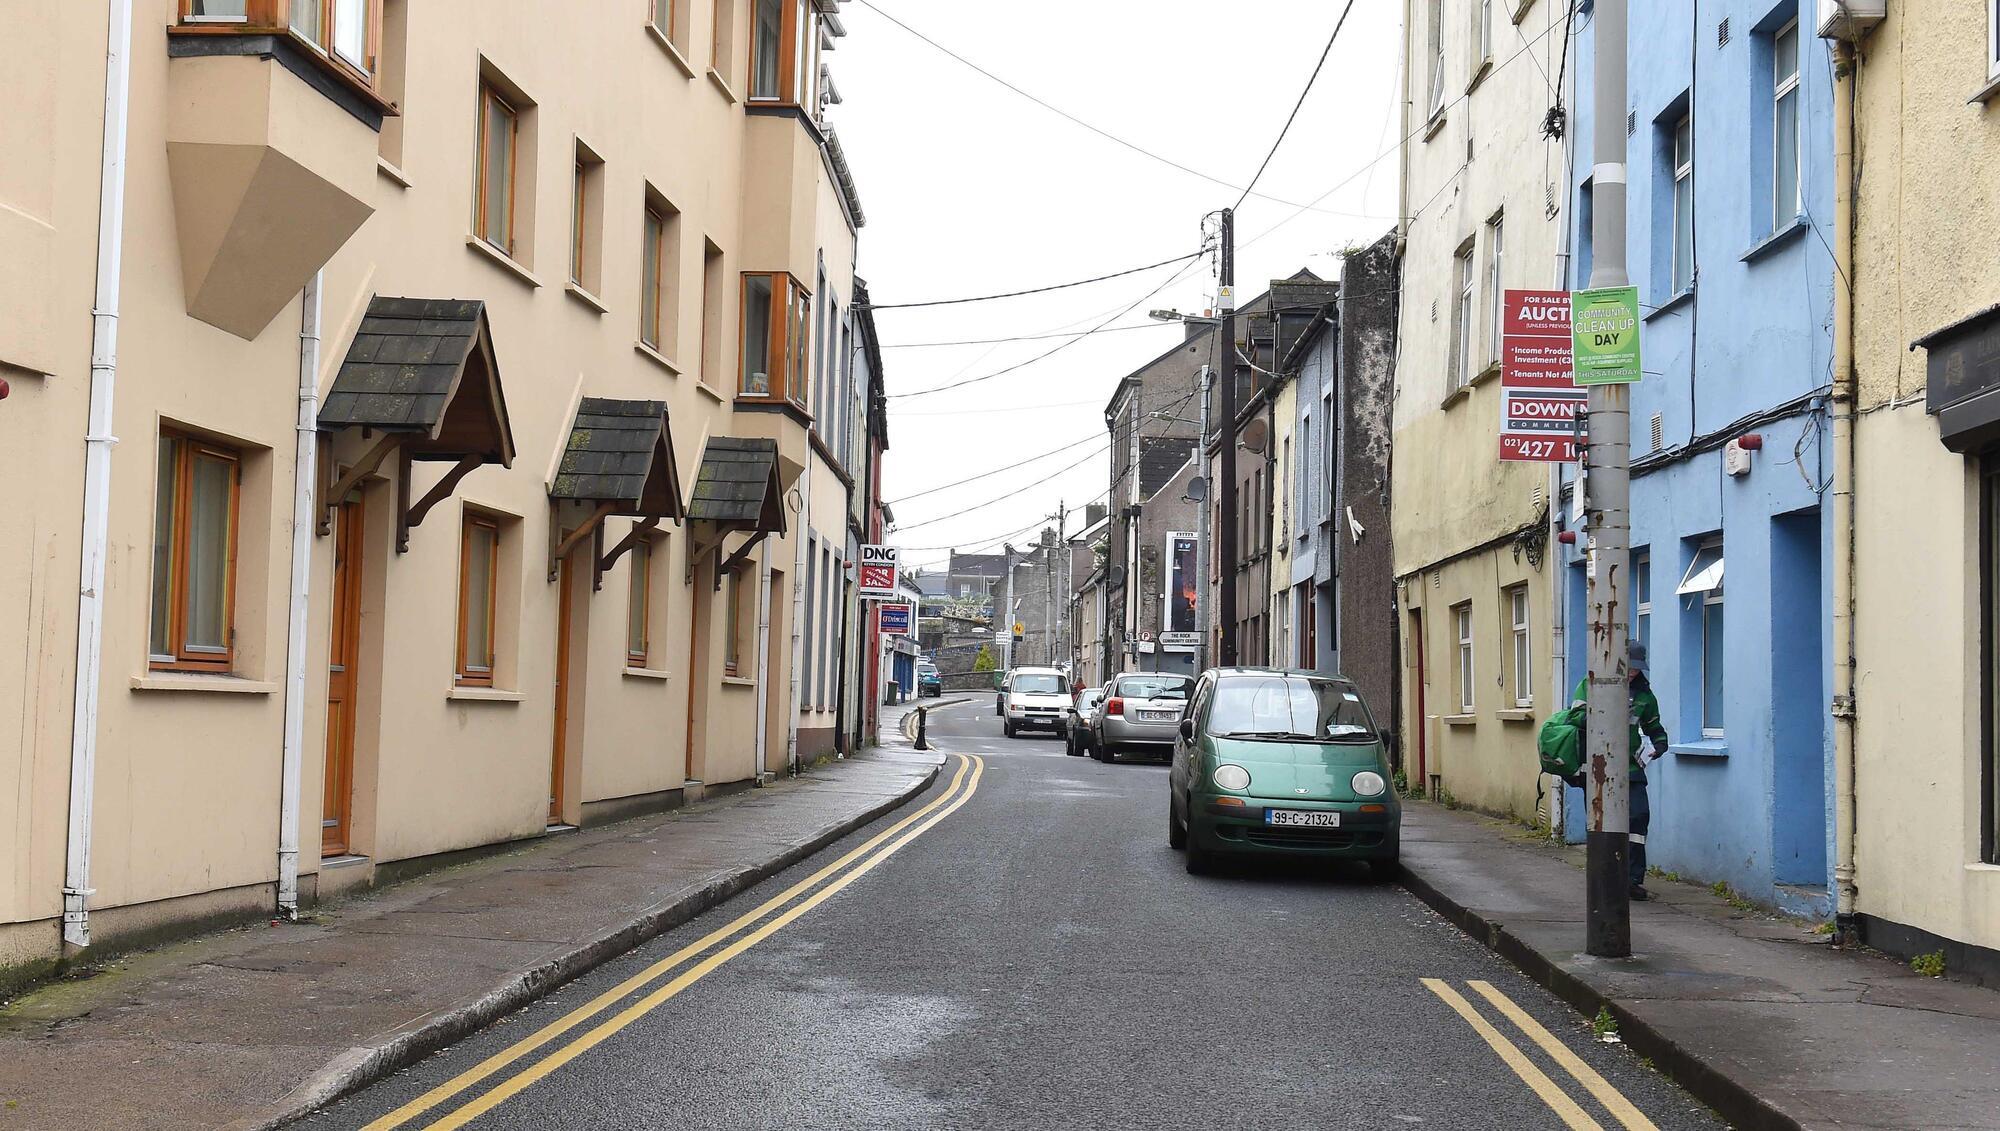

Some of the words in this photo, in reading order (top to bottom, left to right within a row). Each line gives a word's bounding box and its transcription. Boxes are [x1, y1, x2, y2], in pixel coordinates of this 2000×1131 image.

[1524, 296, 1540, 304] FOR
[1541, 296, 1561, 304] SALE
[1577, 307, 1631, 319] COMMUNITY
[1575, 319, 1615, 334] CLEAN
[1619, 318, 1635, 330] UP
[1594, 333, 1620, 346] DAY
[1514, 356, 1557, 364] Investment
[1513, 370, 1544, 378] Tenants
[1545, 371, 1560, 379] Not
[1578, 371, 1595, 379] THIS
[1596, 368, 1638, 378] SATURDAY
[1504, 438, 1521, 447] 021
[1518, 441, 1555, 457] 427
[863, 547, 896, 560] DNG
[1274, 812, 1334, 826] 99-C-21324
